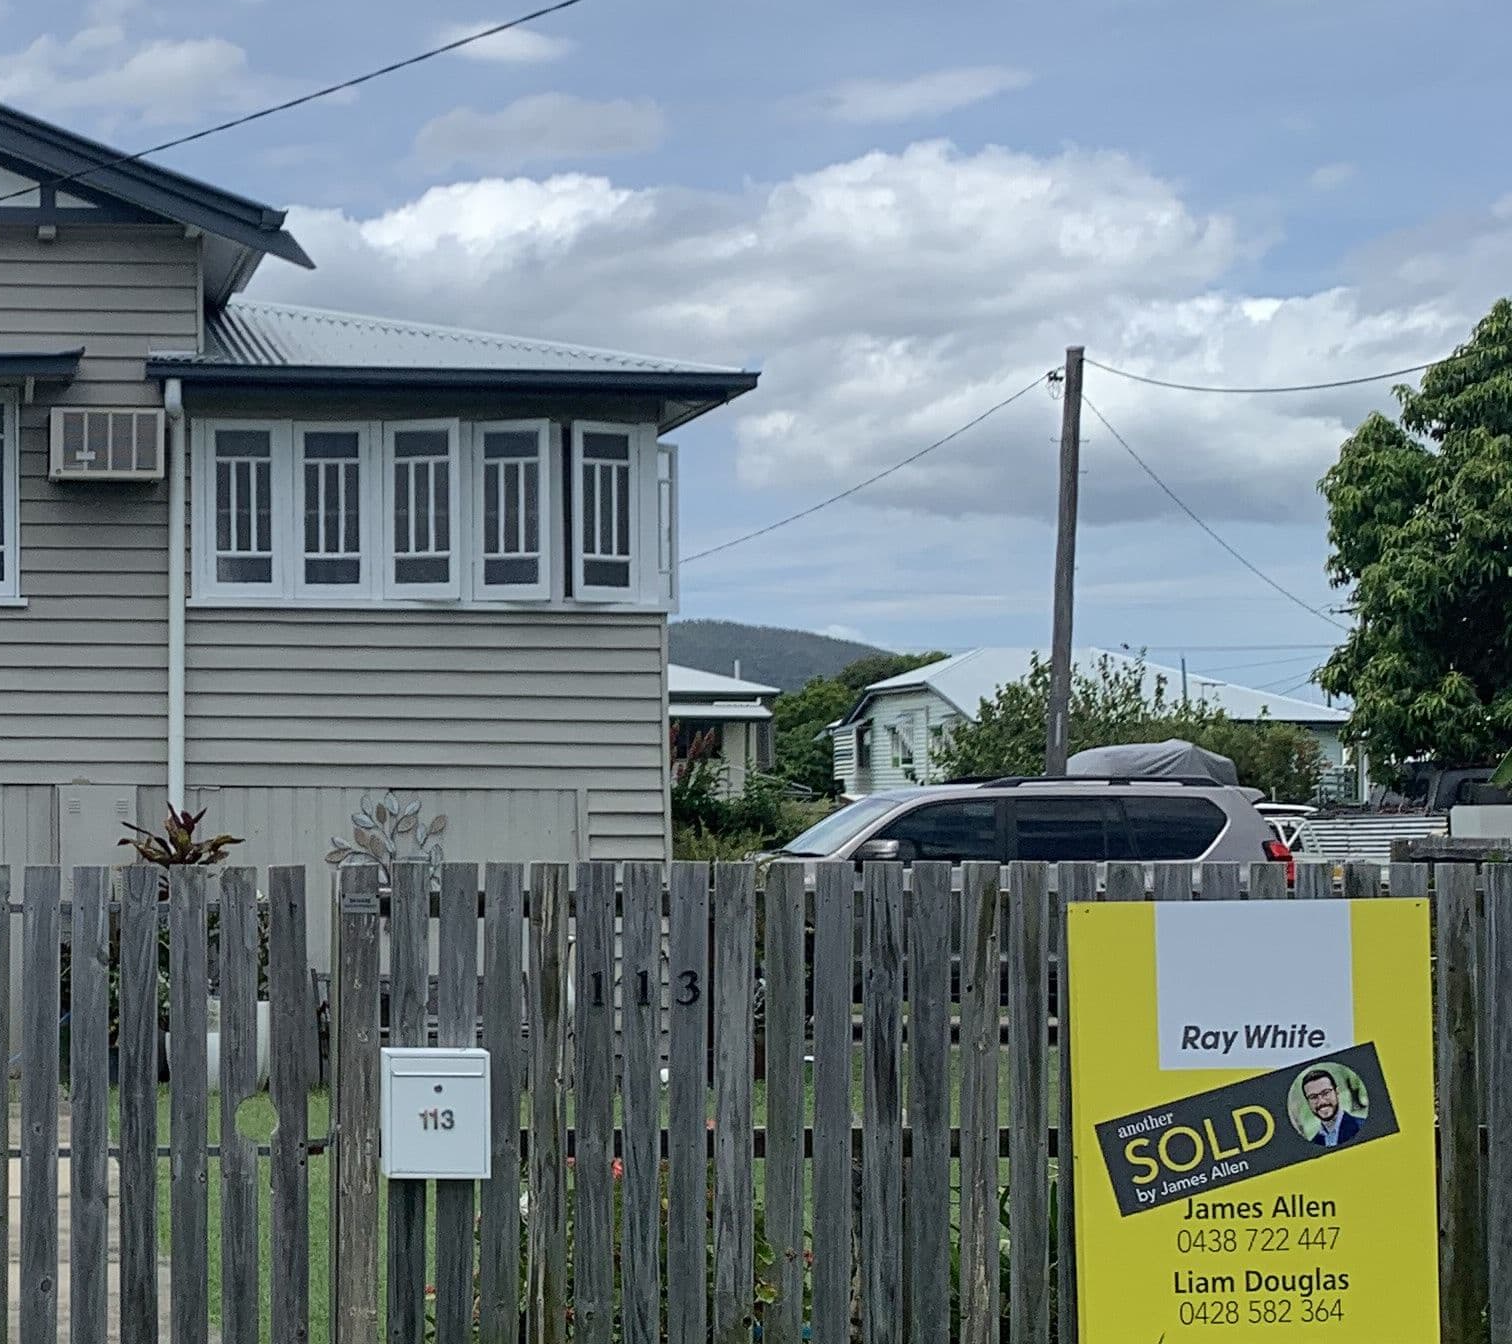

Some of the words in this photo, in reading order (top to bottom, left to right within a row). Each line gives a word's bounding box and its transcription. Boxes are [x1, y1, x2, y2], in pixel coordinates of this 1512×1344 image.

[1181, 1025, 1239, 1055] Ray
[1244, 1024, 1326, 1049] White
[418, 1108, 456, 1131] 113
[1117, 1111, 1174, 1139] another
[1124, 1105, 1275, 1185] SOLD
[1136, 1187, 1157, 1204] by
[1160, 1173, 1208, 1196] James
[1211, 1159, 1249, 1181] Allen
[1184, 1197, 1264, 1220] James
[1272, 1194, 1336, 1218] Allen
[1177, 1229, 1237, 1253] 0438
[1245, 1227, 1290, 1252] 722
[1297, 1226, 1341, 1250] 447
[1174, 1270, 1235, 1294] Liam
[1245, 1267, 1350, 1297] Douglas
[1179, 1301, 1239, 1325] 0428
[1248, 1299, 1292, 1323] 582
[1301, 1299, 1345, 1322] 364
